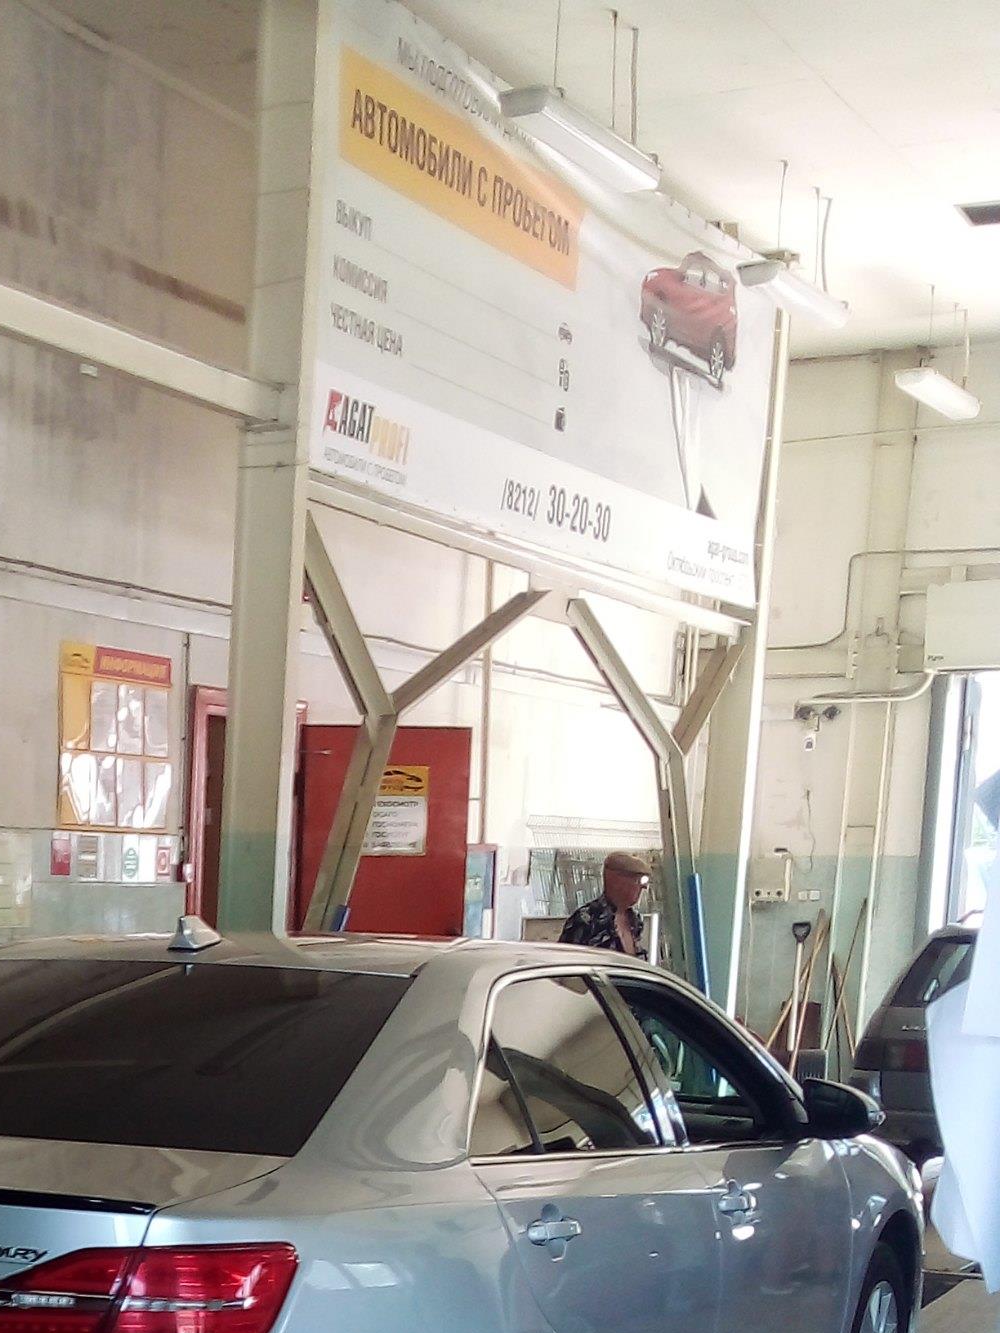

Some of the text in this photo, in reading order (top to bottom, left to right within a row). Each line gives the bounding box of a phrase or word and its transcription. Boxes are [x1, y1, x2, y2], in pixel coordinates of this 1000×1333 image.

[352, 89, 473, 198] АВТОМОБИЛИ
[477, 166, 488, 207] С
[492, 174, 570, 256] ПРОБЕГОМ
[338, 394, 375, 444] AGAT
[546, 483, 612, 543] 30-20-30
